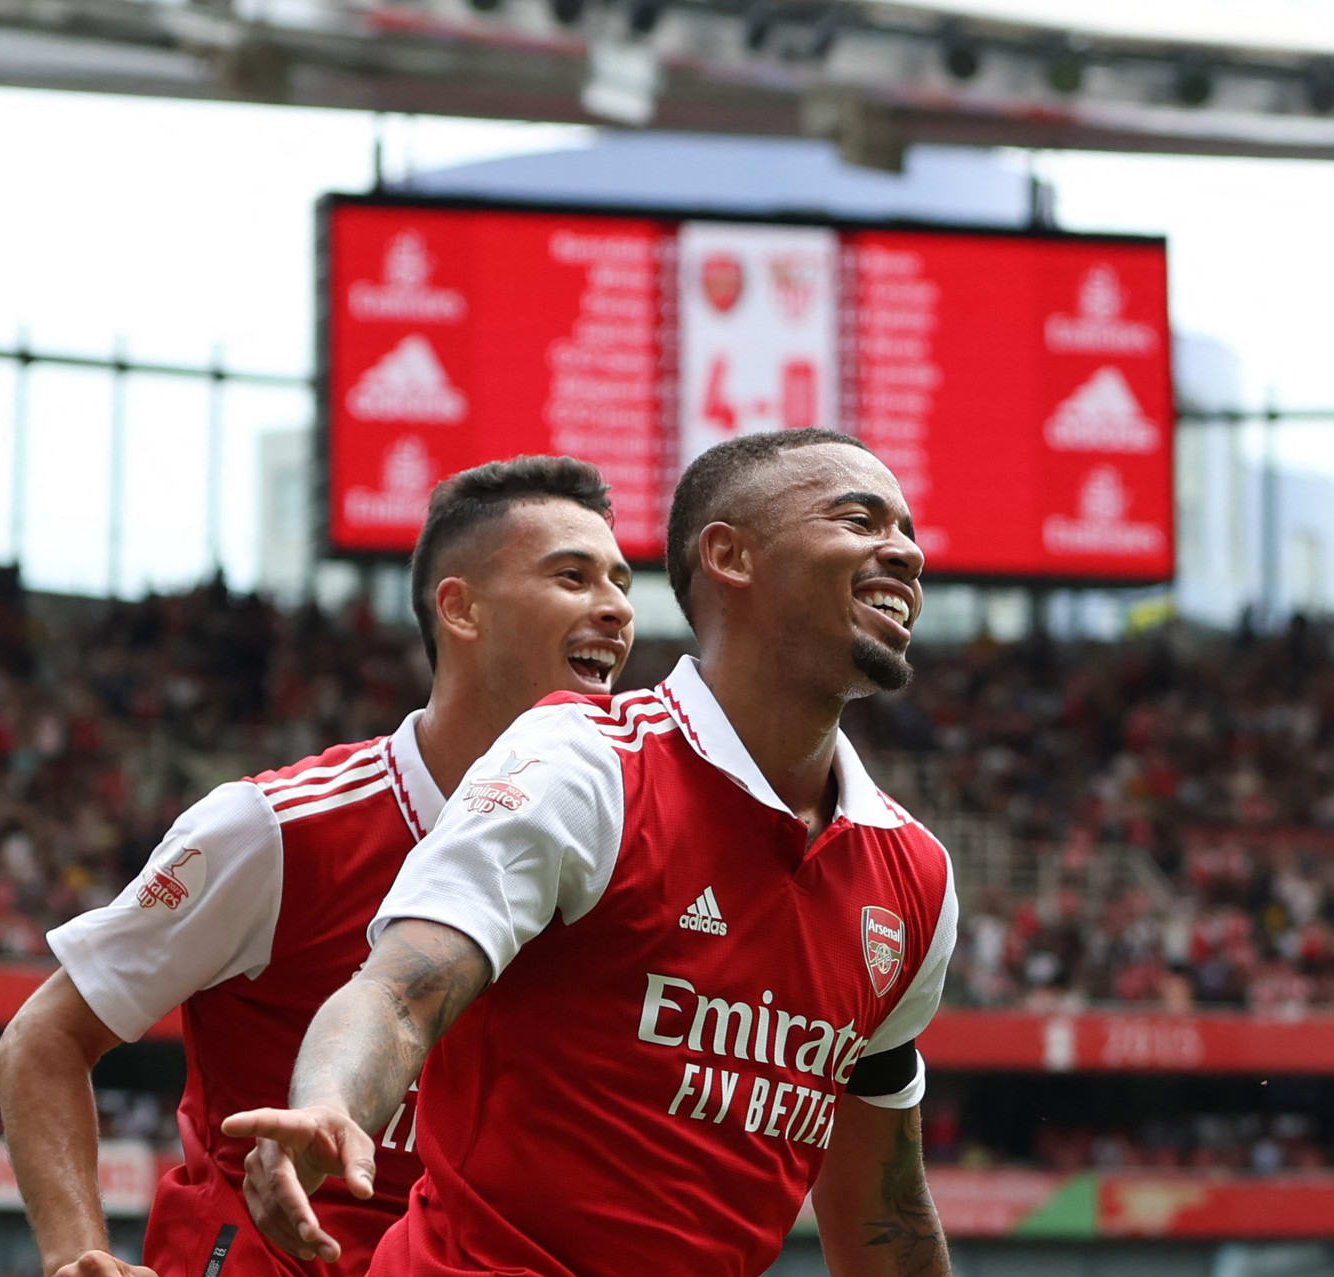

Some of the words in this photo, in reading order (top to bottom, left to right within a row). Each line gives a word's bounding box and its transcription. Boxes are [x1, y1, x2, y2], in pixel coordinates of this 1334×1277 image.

[465, 785, 522, 811] mirates
[679, 912, 728, 936] adidas
[867, 918, 901, 943] Arsenal
[638, 972, 869, 1085] Emirate
[668, 1063, 740, 1124] FLY
